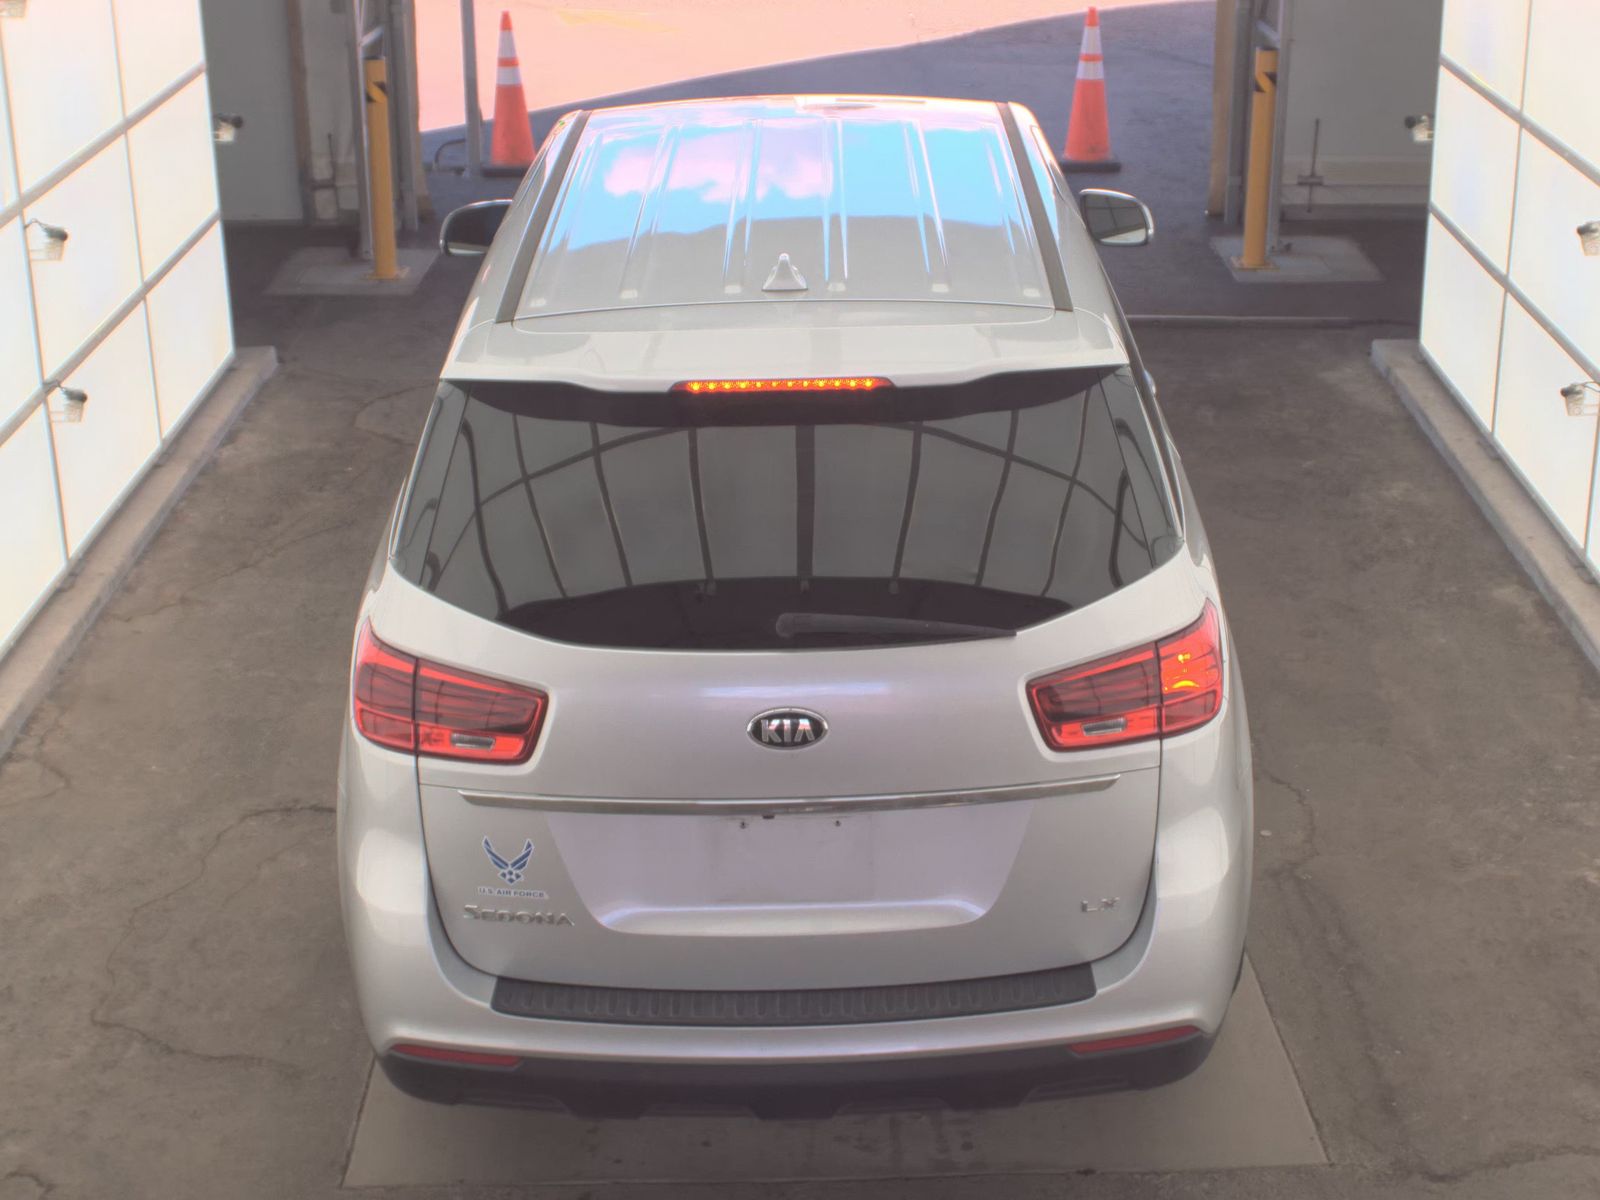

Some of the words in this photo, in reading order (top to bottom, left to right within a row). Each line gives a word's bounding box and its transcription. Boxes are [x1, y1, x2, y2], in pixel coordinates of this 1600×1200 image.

[761, 719, 815, 743] KIA
[513, 890, 545, 898] FORCE
[463, 904, 575, 926] SEDONA
